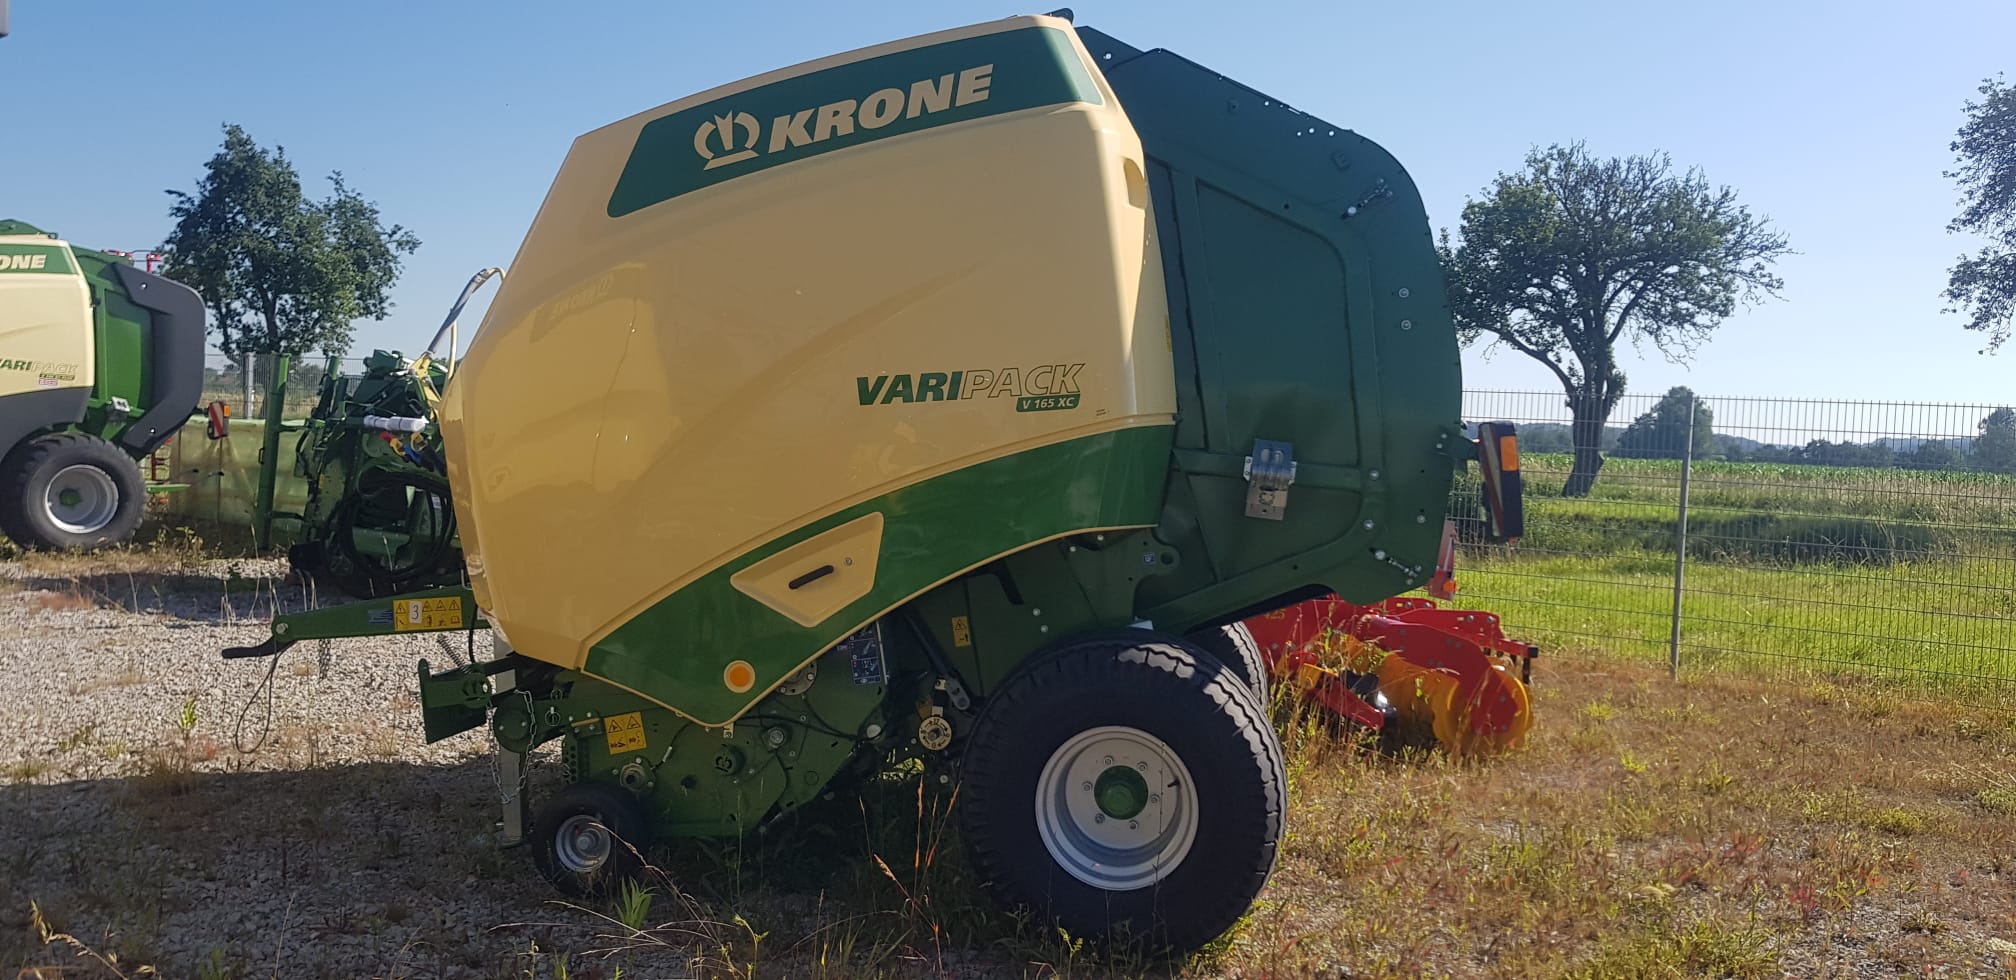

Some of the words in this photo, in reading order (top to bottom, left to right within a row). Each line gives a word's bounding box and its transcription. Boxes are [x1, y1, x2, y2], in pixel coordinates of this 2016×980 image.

[768, 63, 994, 153] KRONE
[0, 359, 78, 373] ARIPACK
[856, 363, 1085, 406] VARIPACK
[1022, 399, 1031, 409] V
[1034, 398, 1055, 409] 165
[1057, 397, 1075, 407] XC
[411, 604, 419, 620] 3
